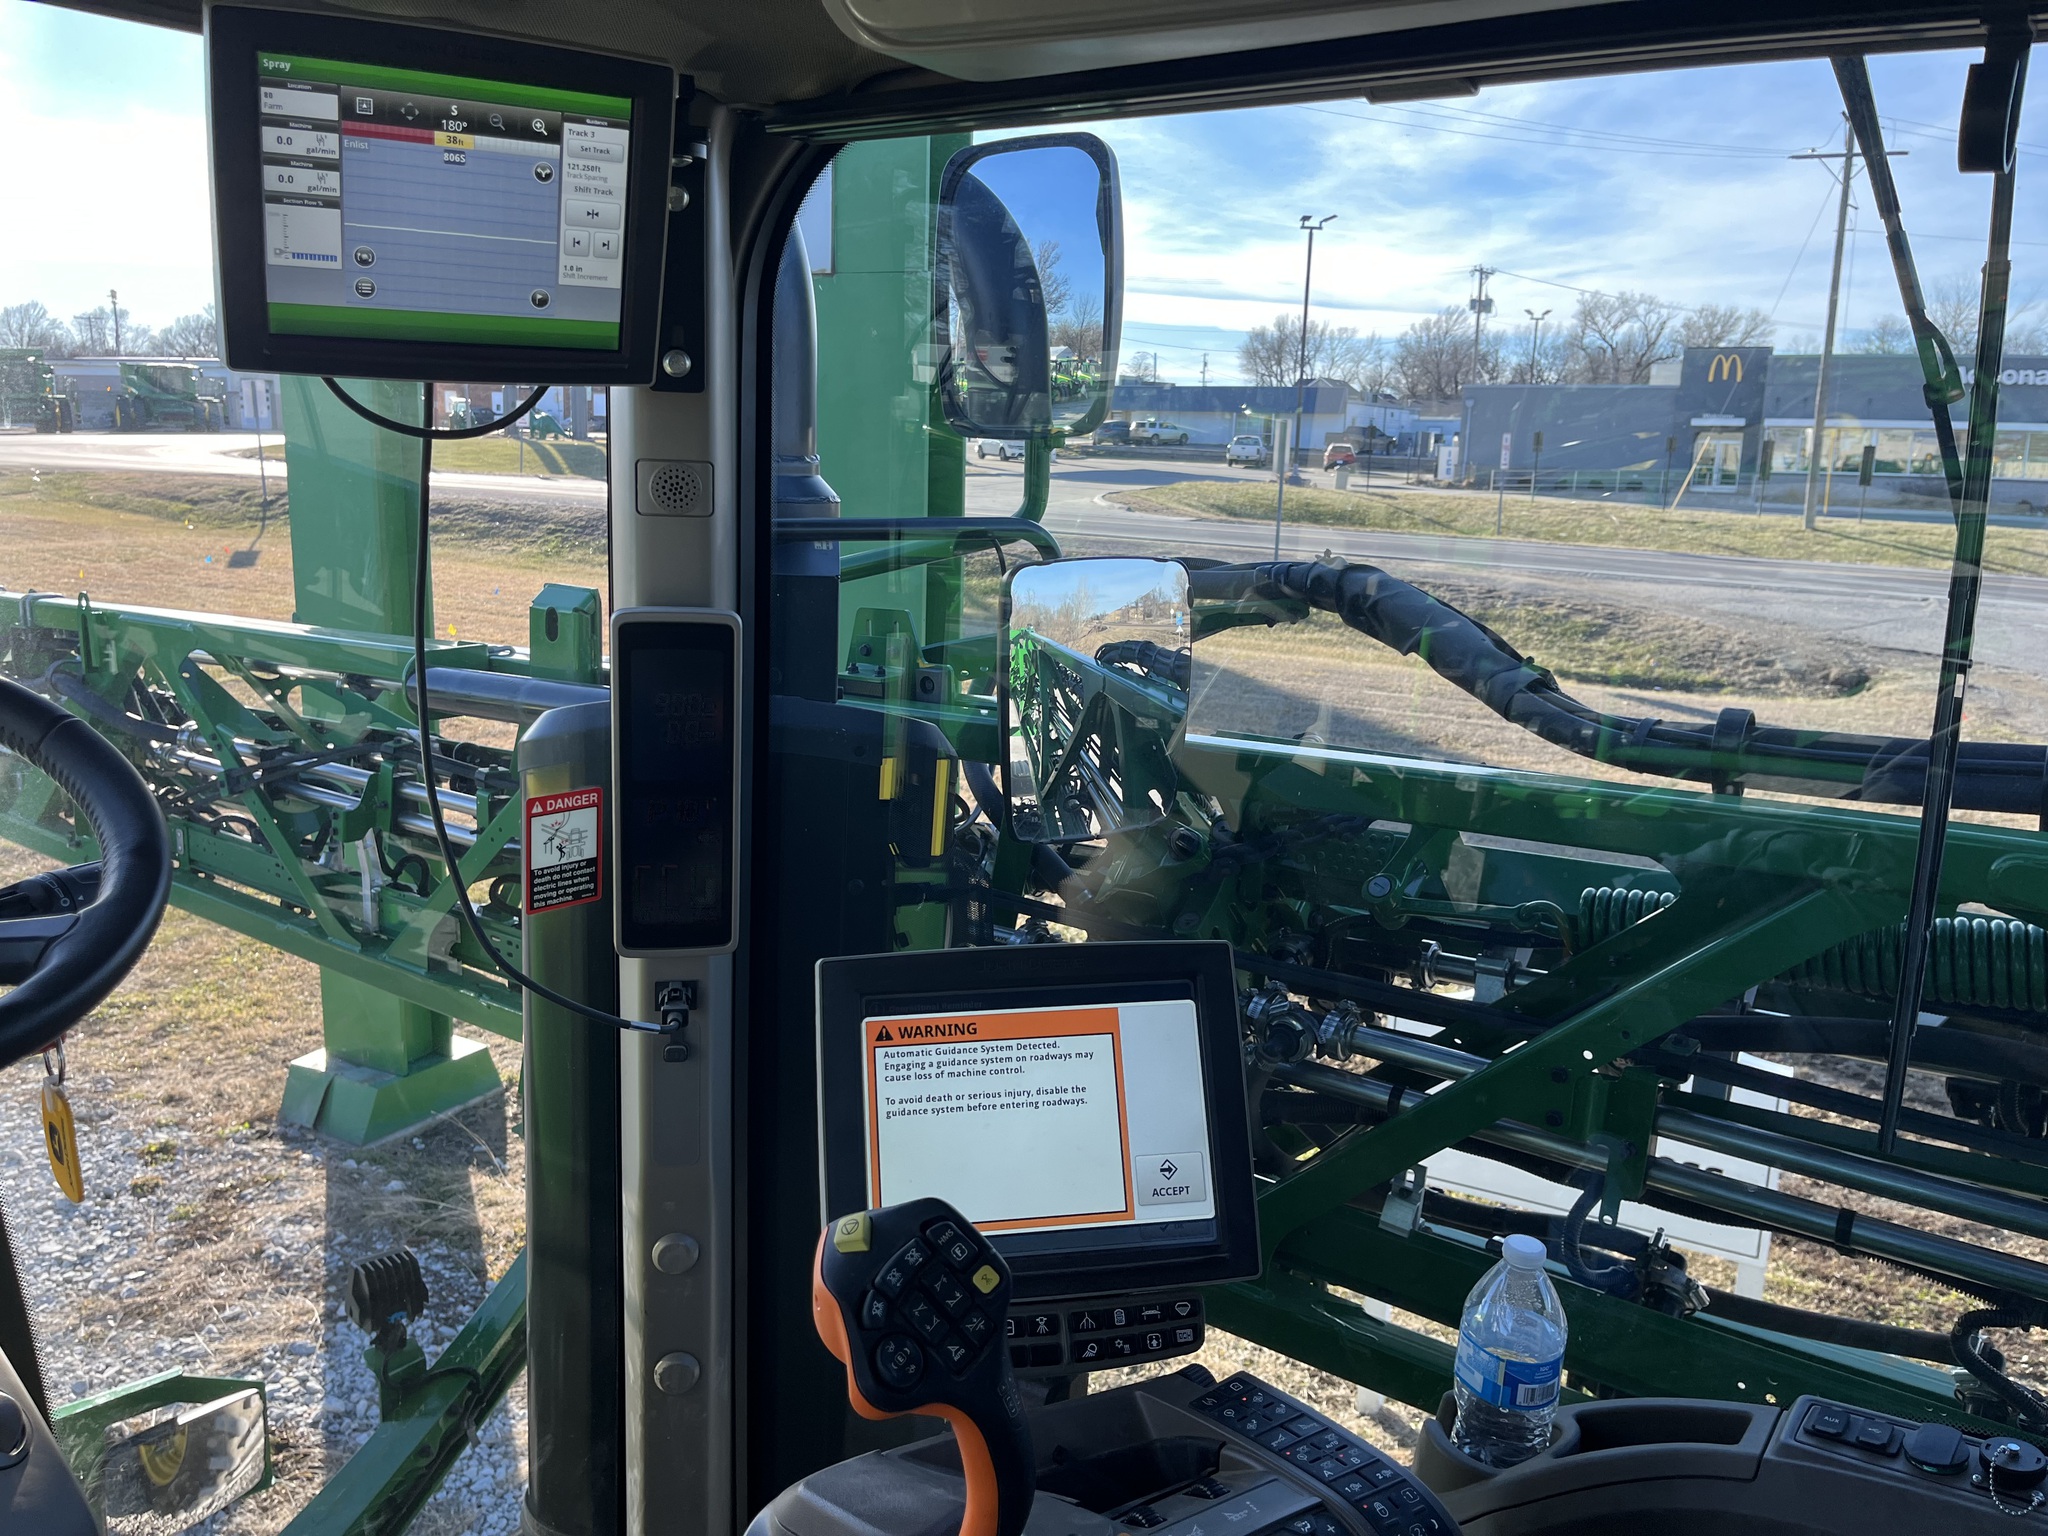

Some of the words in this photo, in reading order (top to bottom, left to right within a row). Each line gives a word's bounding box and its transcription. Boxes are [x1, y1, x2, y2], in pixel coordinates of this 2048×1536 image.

[263, 59, 291, 71] Spray
[263, 102, 284, 110] Farm
[451, 105, 458, 116] S
[568, 128, 589, 138] Track
[591, 131, 596, 139] 3
[276, 136, 293, 146] 0.0
[344, 140, 369, 150] Enlist
[306, 146, 336, 156] gal/min
[580, 145, 592, 153] Set
[593, 147, 611, 155] Track
[278, 174, 294, 184] 0.0
[566, 171, 583, 180] Track
[584, 174, 608, 184] Spacing
[307, 185, 337, 193] gal/min
[574, 185, 592, 193] Shift
[593, 187, 613, 196] Track
[575, 265, 583, 273] in
[562, 272, 576, 280] Shift
[577, 273, 608, 281] Increment
[546, 792, 598, 812] DANGER
[543, 865, 561, 875] avoid
[561, 862, 579, 871] injury
[533, 876, 552, 884] death
[572, 866, 596, 876] contact
[533, 882, 557, 892] electric
[533, 890, 557, 900] moving
[565, 882, 595, 893] operating
[898, 1022, 978, 1039] WARNING
[883, 1048, 933, 1059] Automatic
[935, 1046, 978, 1056] Guidance
[980, 1044, 1013, 1055] System
[1016, 1040, 1060, 1051] Detected.
[884, 1060, 926, 1072] Engaging
[936, 1057, 978, 1069] guidance
[980, 1055, 1013, 1066] system
[1015, 1055, 1027, 1063] on
[1029, 1052, 1072, 1062] roadways
[1075, 1051, 1094, 1060] may
[884, 1074, 912, 1083] cause
[914, 1071, 932, 1080] loss
[935, 1070, 945, 1079] of
[947, 1067, 987, 1078] machine
[989, 1065, 1025, 1076] control.
[885, 1097, 896, 1106] To
[898, 1095, 923, 1104] avoid
[925, 1093, 953, 1103] death
[967, 1090, 1002, 1100] serious
[1004, 1088, 1034, 1099] injury,
[1036, 1085, 1069, 1096] disable
[1071, 1084, 1087, 1093] the
[886, 1107, 929, 1119] guidance
[931, 1105, 964, 1116] system
[967, 1102, 998, 1112] before
[1000, 1098, 1040, 1110] entering
[1042, 1096, 1088, 1107] roadways.
[1152, 1185, 1191, 1198] ACCEPT
[938, 1229, 954, 1245] HMS
[1823, 1416, 1840, 1424] AUX
[1325, 1440, 1339, 1449] AUTO
[1350, 1456, 1360, 1464] B
[1323, 1469, 1334, 1478] A
